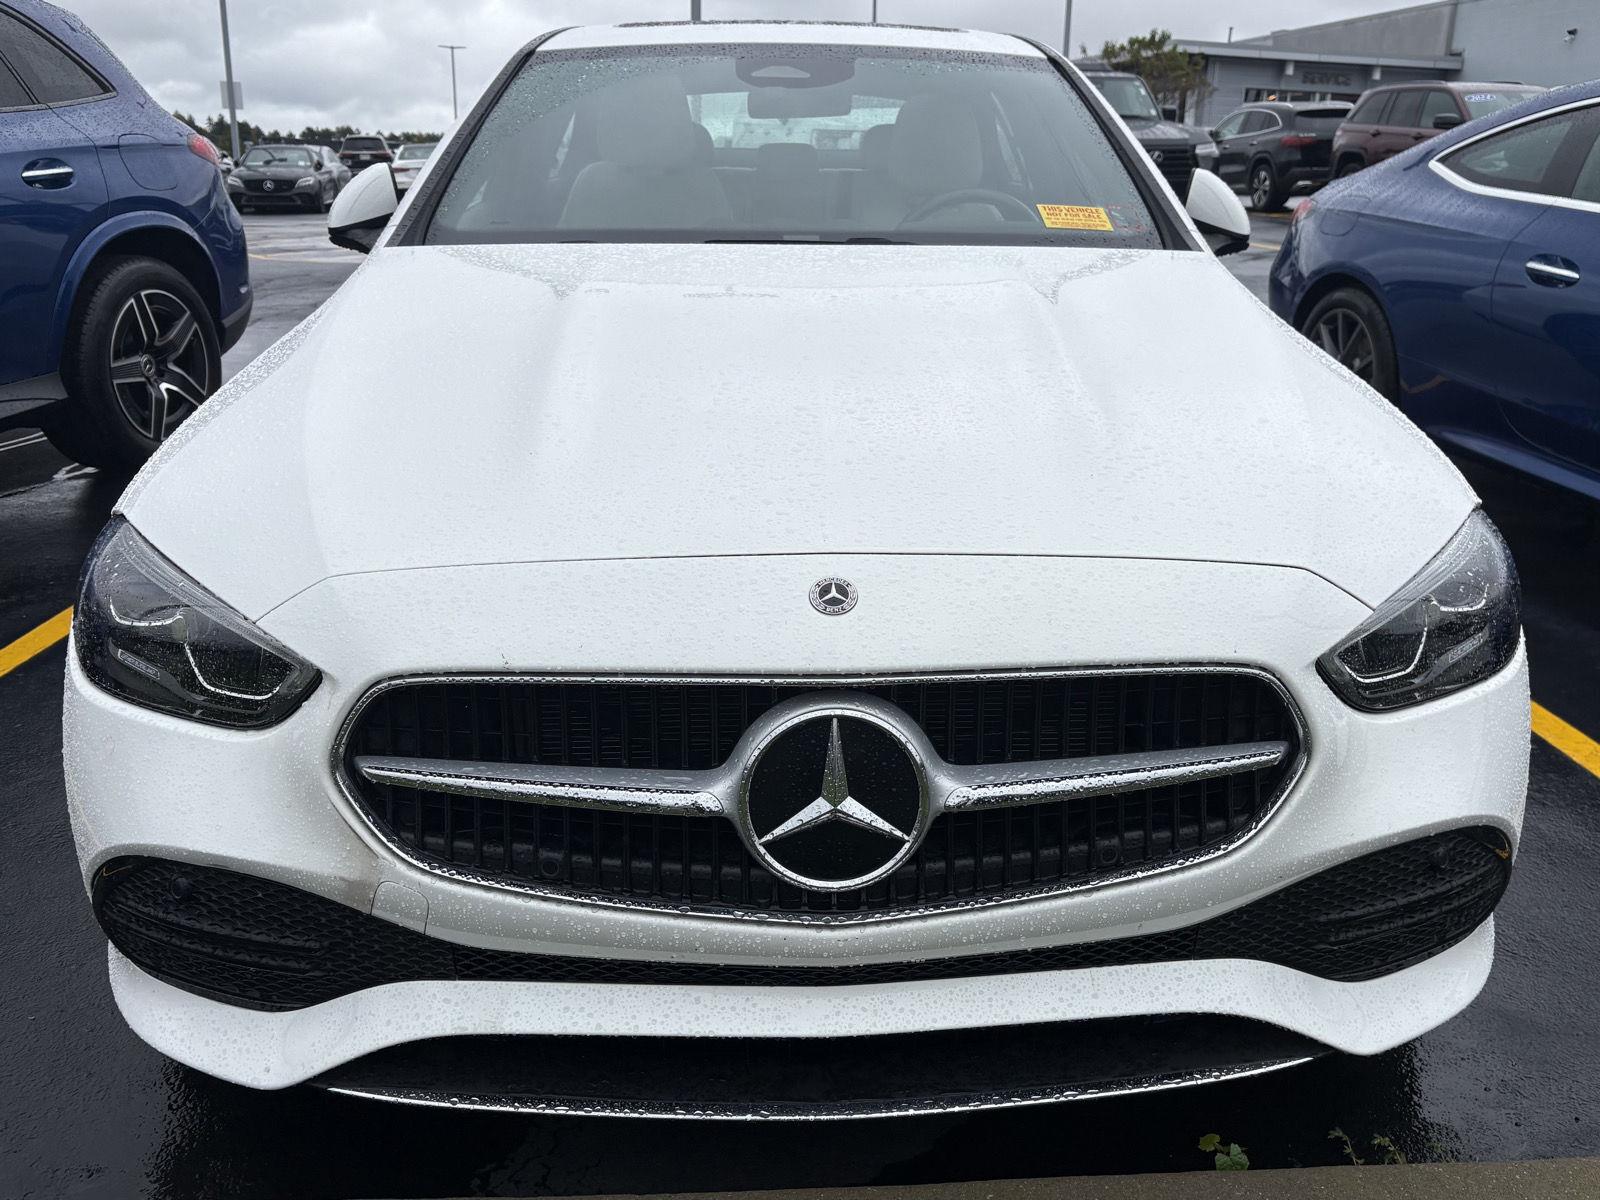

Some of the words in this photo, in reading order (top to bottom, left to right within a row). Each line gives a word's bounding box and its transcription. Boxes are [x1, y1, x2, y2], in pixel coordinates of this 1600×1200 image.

[1302, 72, 1351, 86] SERVICE
[1041, 205, 1063, 213] THIS
[1063, 206, 1102, 215] VEHICLE
